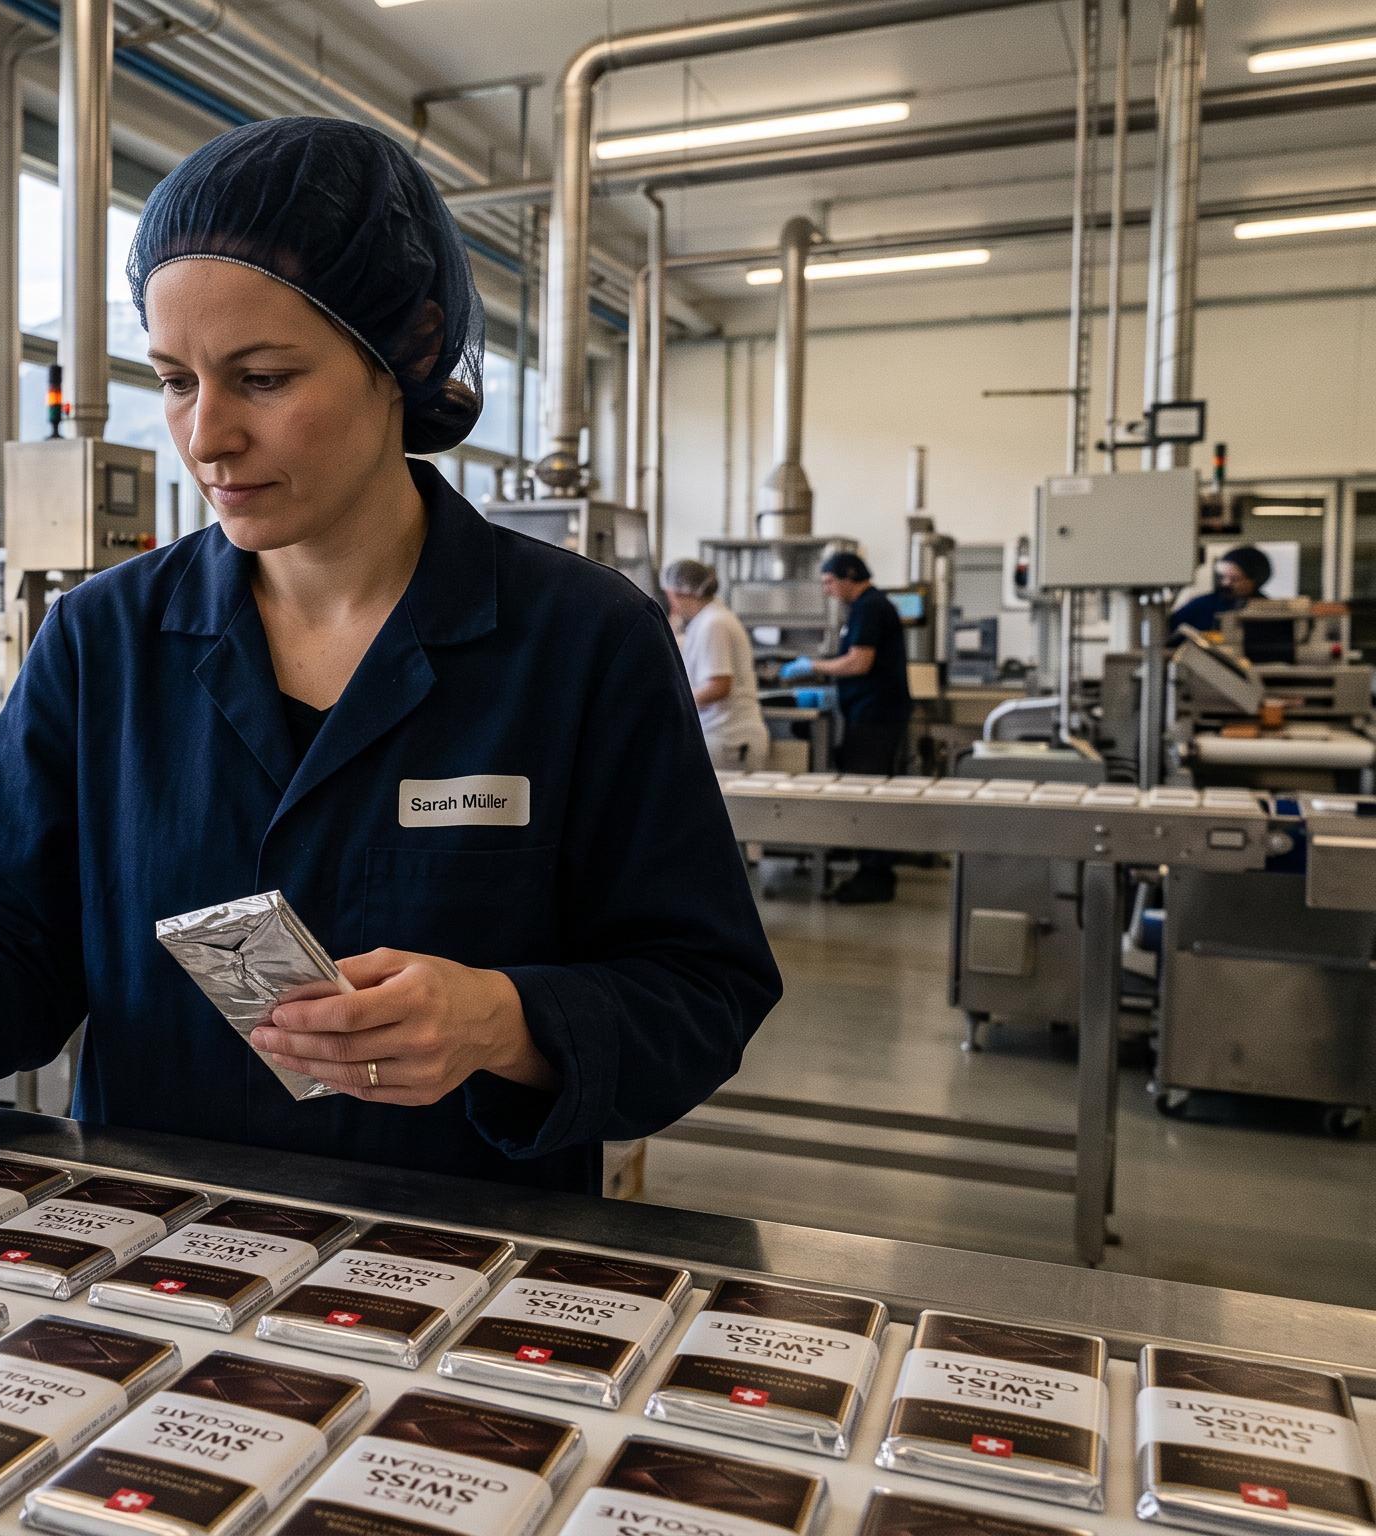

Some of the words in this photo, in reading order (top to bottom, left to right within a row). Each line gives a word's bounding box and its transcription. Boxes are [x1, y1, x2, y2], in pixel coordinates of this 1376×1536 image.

[411, 797, 457, 811] Sarah
[462, 794, 507, 808] Müller
[184, 1240, 259, 1258] SWISS
[344, 1278, 414, 1292] FINEST
[345, 1267, 430, 1287] SWISS
[526, 1298, 614, 1319] SWISS
[526, 1309, 600, 1326] FINEST
[725, 1333, 825, 1357] SWISS
[729, 1346, 812, 1365] FINEST
[946, 1374, 1055, 1401] SWISS
[951, 1387, 1043, 1410] FINEST
[153, 1421, 254, 1452] SWISS
[1193, 1414, 1313, 1444] SWISS
[146, 1435, 231, 1463] FINEST
[1203, 1431, 1306, 1455] FINEST
[366, 1468, 478, 1505] SWISS
[363, 1486, 459, 1516] FINEST
[596, 1504, 734, 1536] OCOLATE
